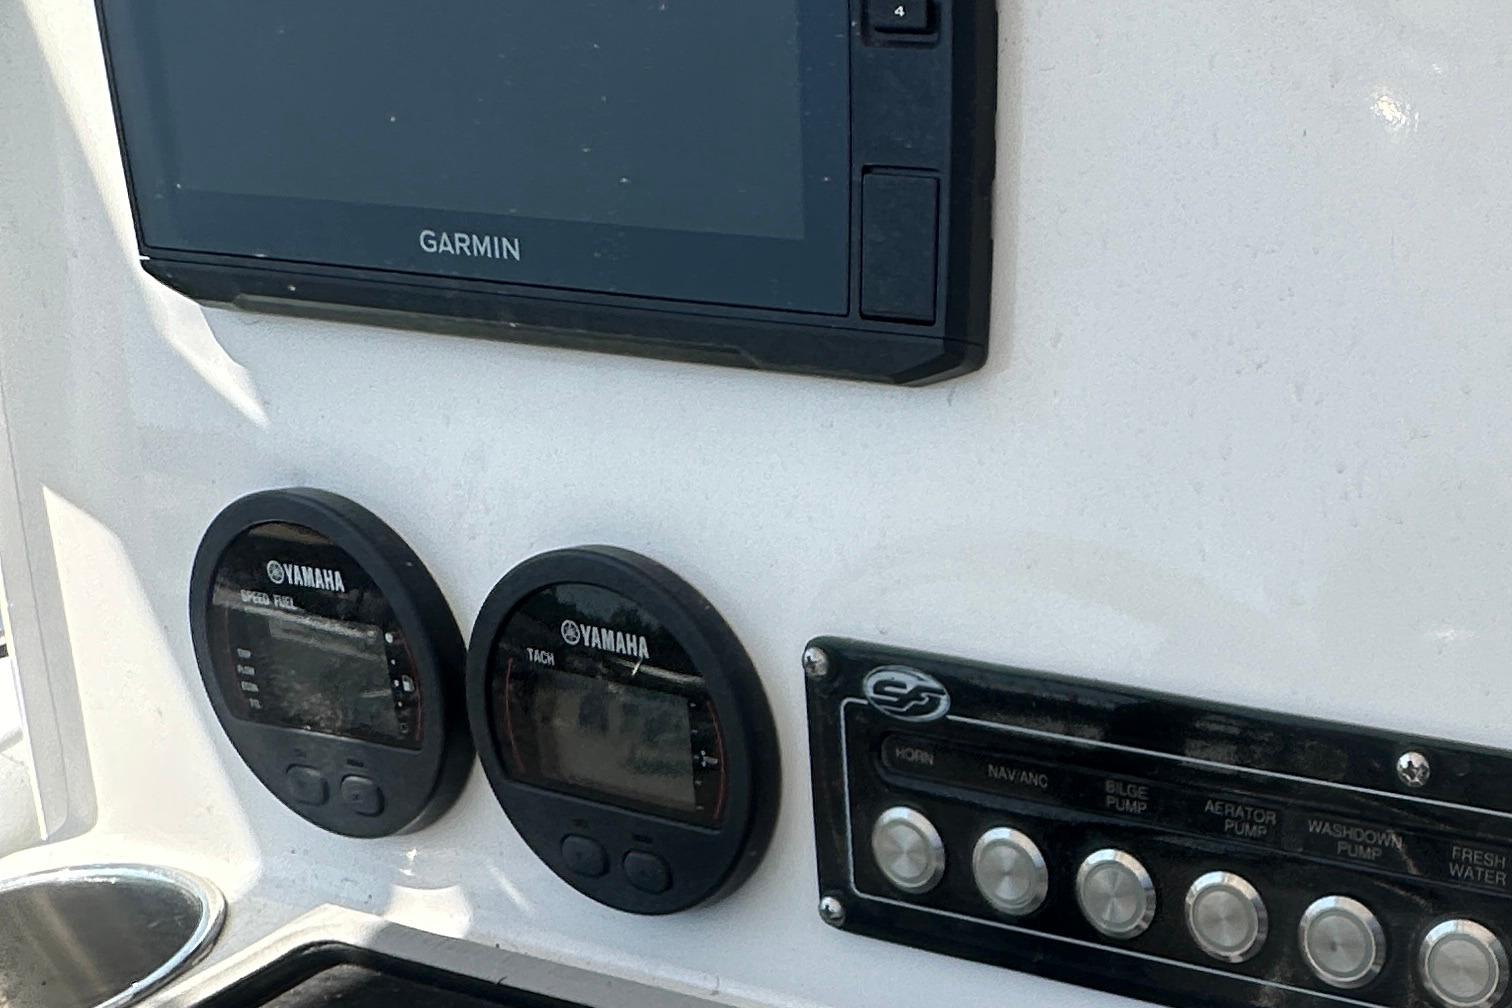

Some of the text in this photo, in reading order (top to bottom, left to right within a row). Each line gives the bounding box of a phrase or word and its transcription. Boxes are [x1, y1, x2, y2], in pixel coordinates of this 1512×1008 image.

[893, 5, 905, 17] 4
[419, 229, 521, 261] GARMIN
[282, 563, 346, 593] YAMAHA
[240, 589, 298, 610] SPEED FUEL
[579, 623, 650, 660] YAMAHA
[526, 647, 556, 666] TACH
[895, 747, 935, 766] HORN
[987, 763, 1049, 789] NAV/ANC
[1104, 779, 1149, 801] BILGE
[1105, 795, 1148, 814] PUMP
[1204, 799, 1278, 826] AERATOR
[1223, 818, 1268, 838] PUMP
[1307, 818, 1404, 850] WASHDOWN
[1336, 841, 1382, 861] PUMP
[1451, 846, 1507, 870] FRESH
[1449, 861, 1508, 886] WATER
